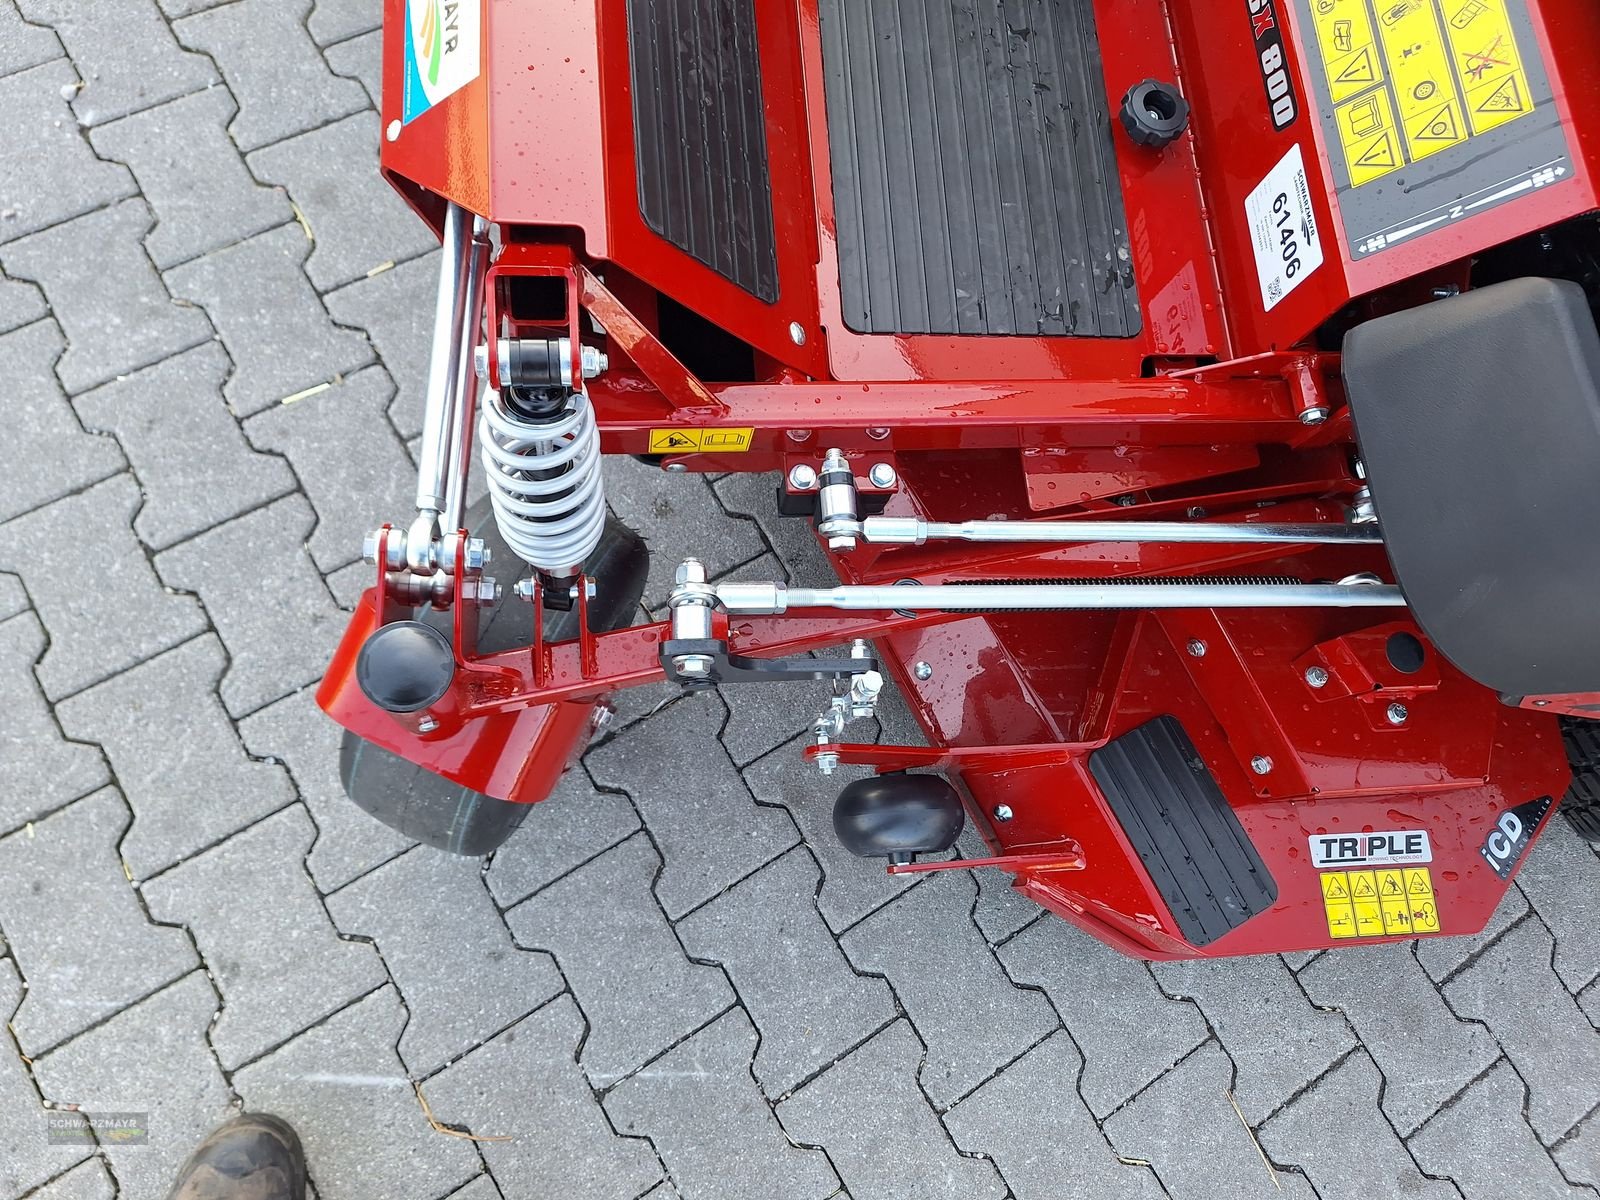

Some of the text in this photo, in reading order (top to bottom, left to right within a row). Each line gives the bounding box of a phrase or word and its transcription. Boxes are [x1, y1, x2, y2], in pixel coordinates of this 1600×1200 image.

[445, 0, 458, 55] AYR
[1261, 43, 1294, 127] 800
[1272, 192, 1301, 279] 61406
[1297, 169, 1315, 237] SCHWARZMAYR
[1319, 834, 1423, 858] TRIPLE
[1481, 811, 1522, 872] iCD
[1501, 799, 1551, 877] CUTTING SYSTEM
